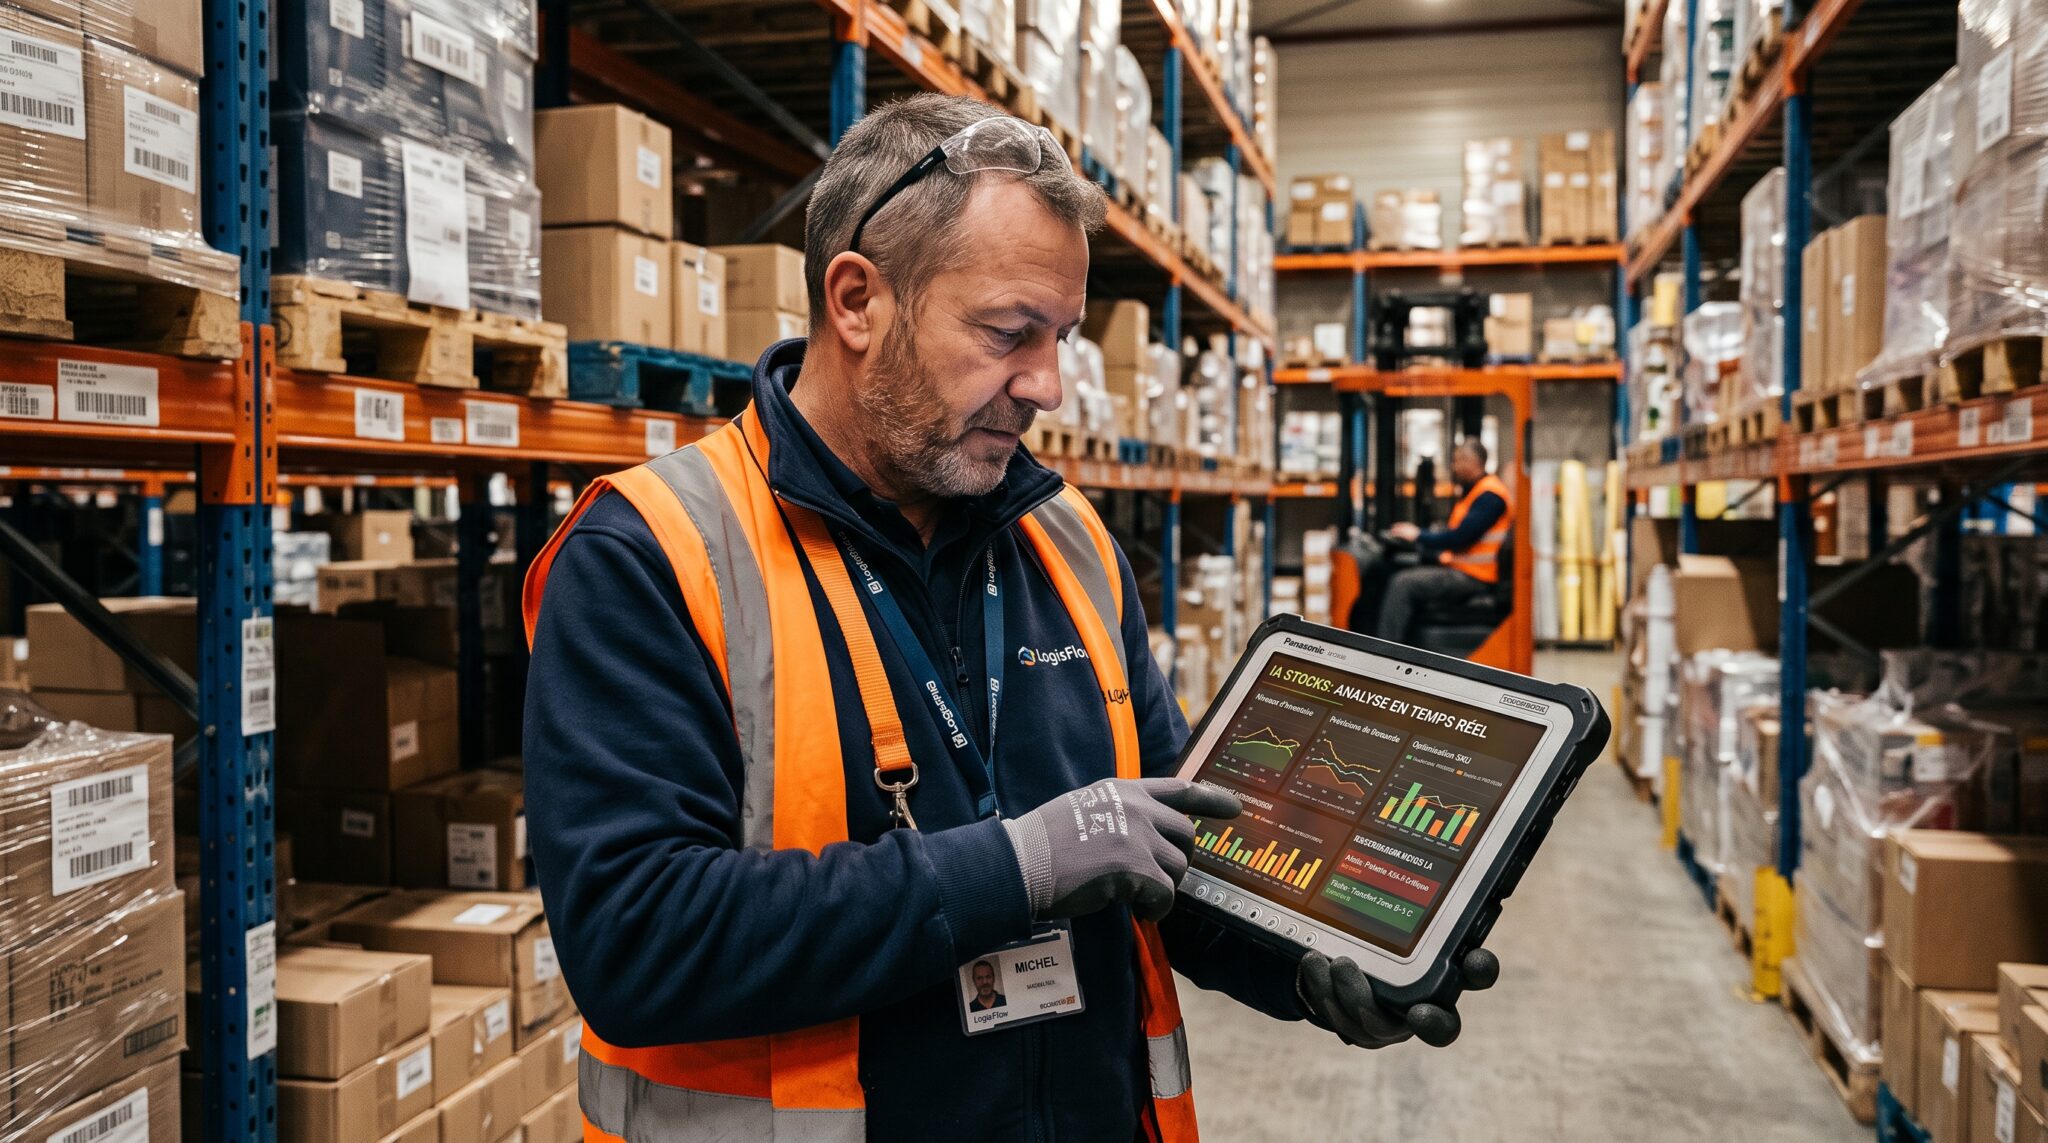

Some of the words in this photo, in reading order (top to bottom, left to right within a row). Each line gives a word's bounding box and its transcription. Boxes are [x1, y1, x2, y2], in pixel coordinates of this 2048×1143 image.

[1283, 637, 1325, 655] Panasonic
[1269, 665, 1281, 678] IA
[1283, 669, 1334, 692] STOCKS:
[1333, 684, 1390, 709] ANALYSE
[1389, 699, 1409, 715] EN
[1410, 705, 1456, 728] TEMPS
[1455, 719, 1488, 739] RÉEL
[1015, 956, 1058, 973] MICHEL
